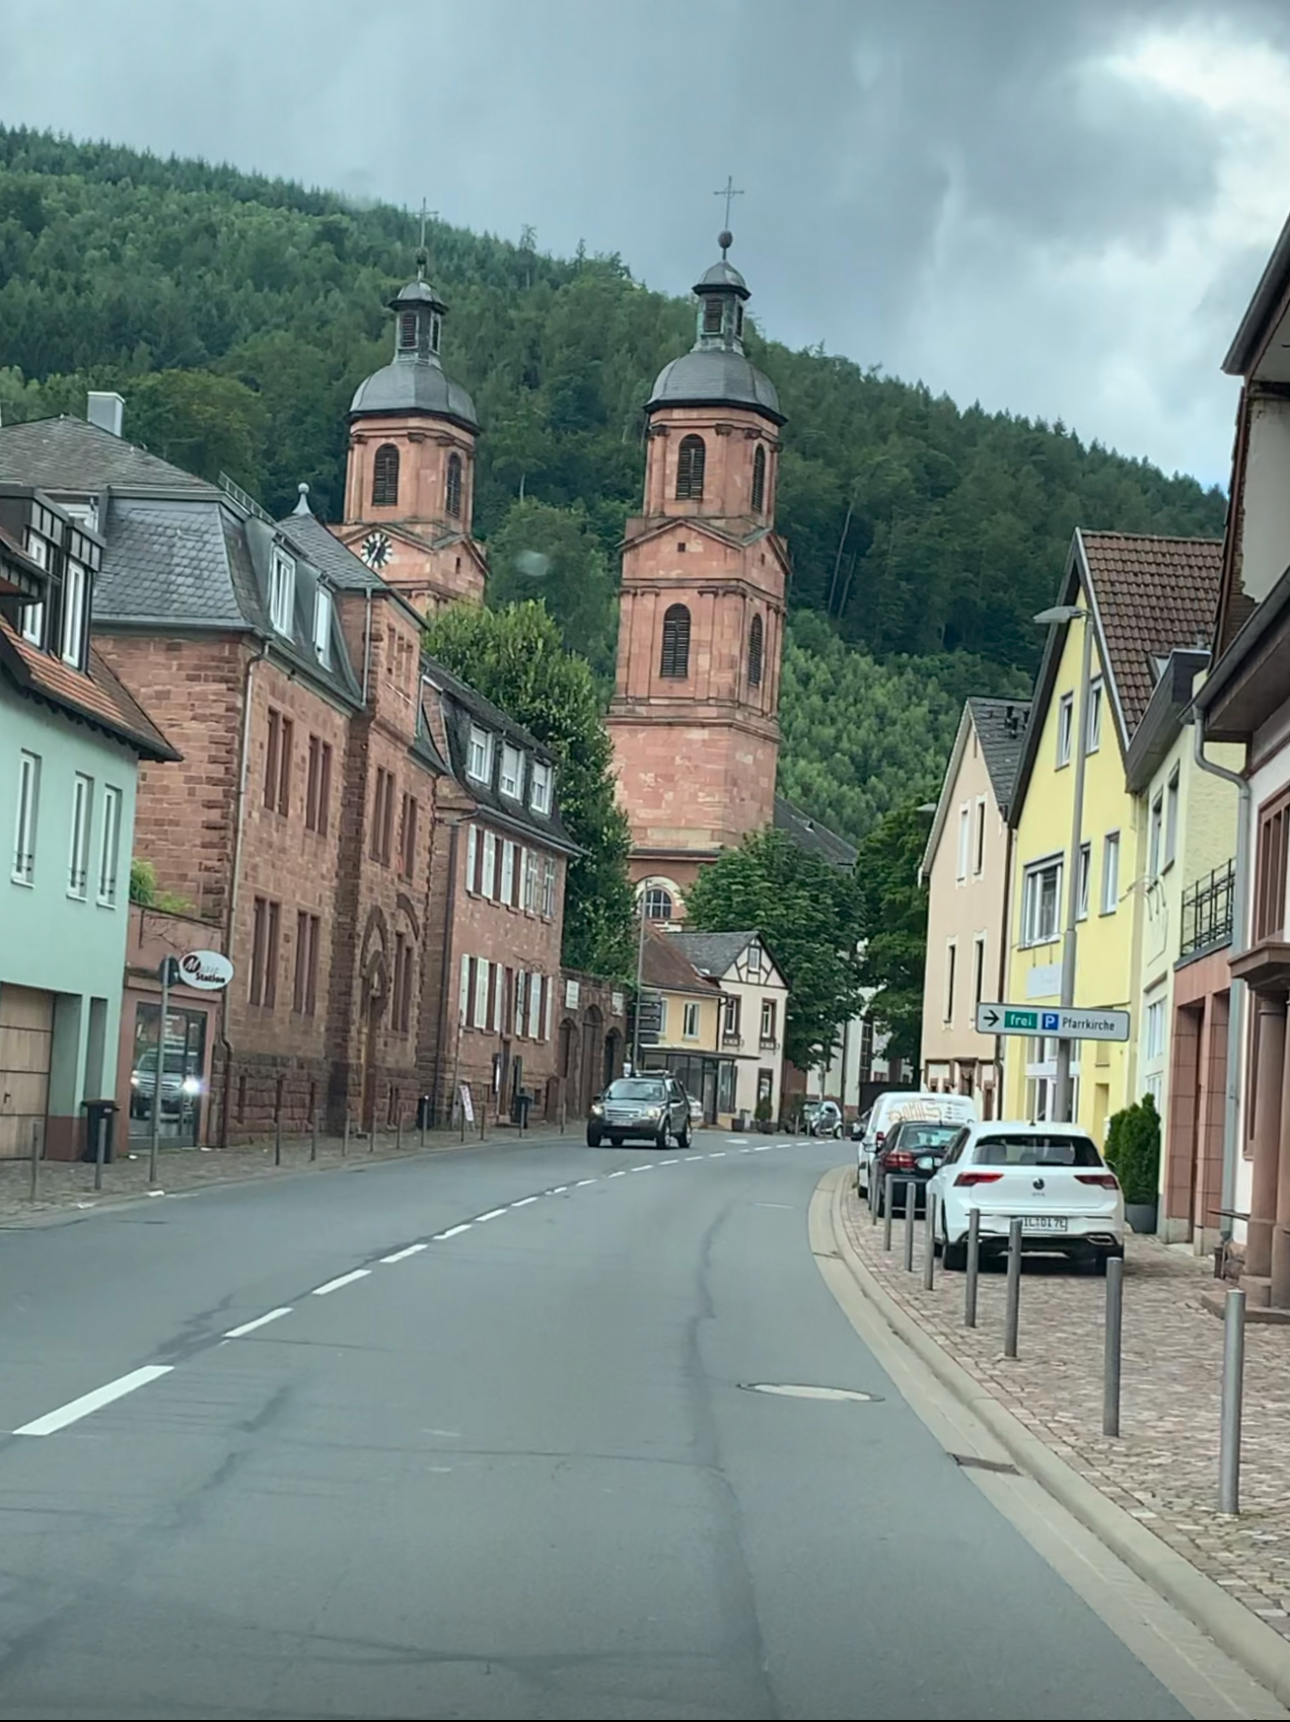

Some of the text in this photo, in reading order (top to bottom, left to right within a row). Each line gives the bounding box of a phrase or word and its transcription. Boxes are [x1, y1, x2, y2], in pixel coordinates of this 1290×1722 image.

[196, 972, 226, 983] Station
[1010, 1013, 1116, 1031] frei P Pfarrkirche
